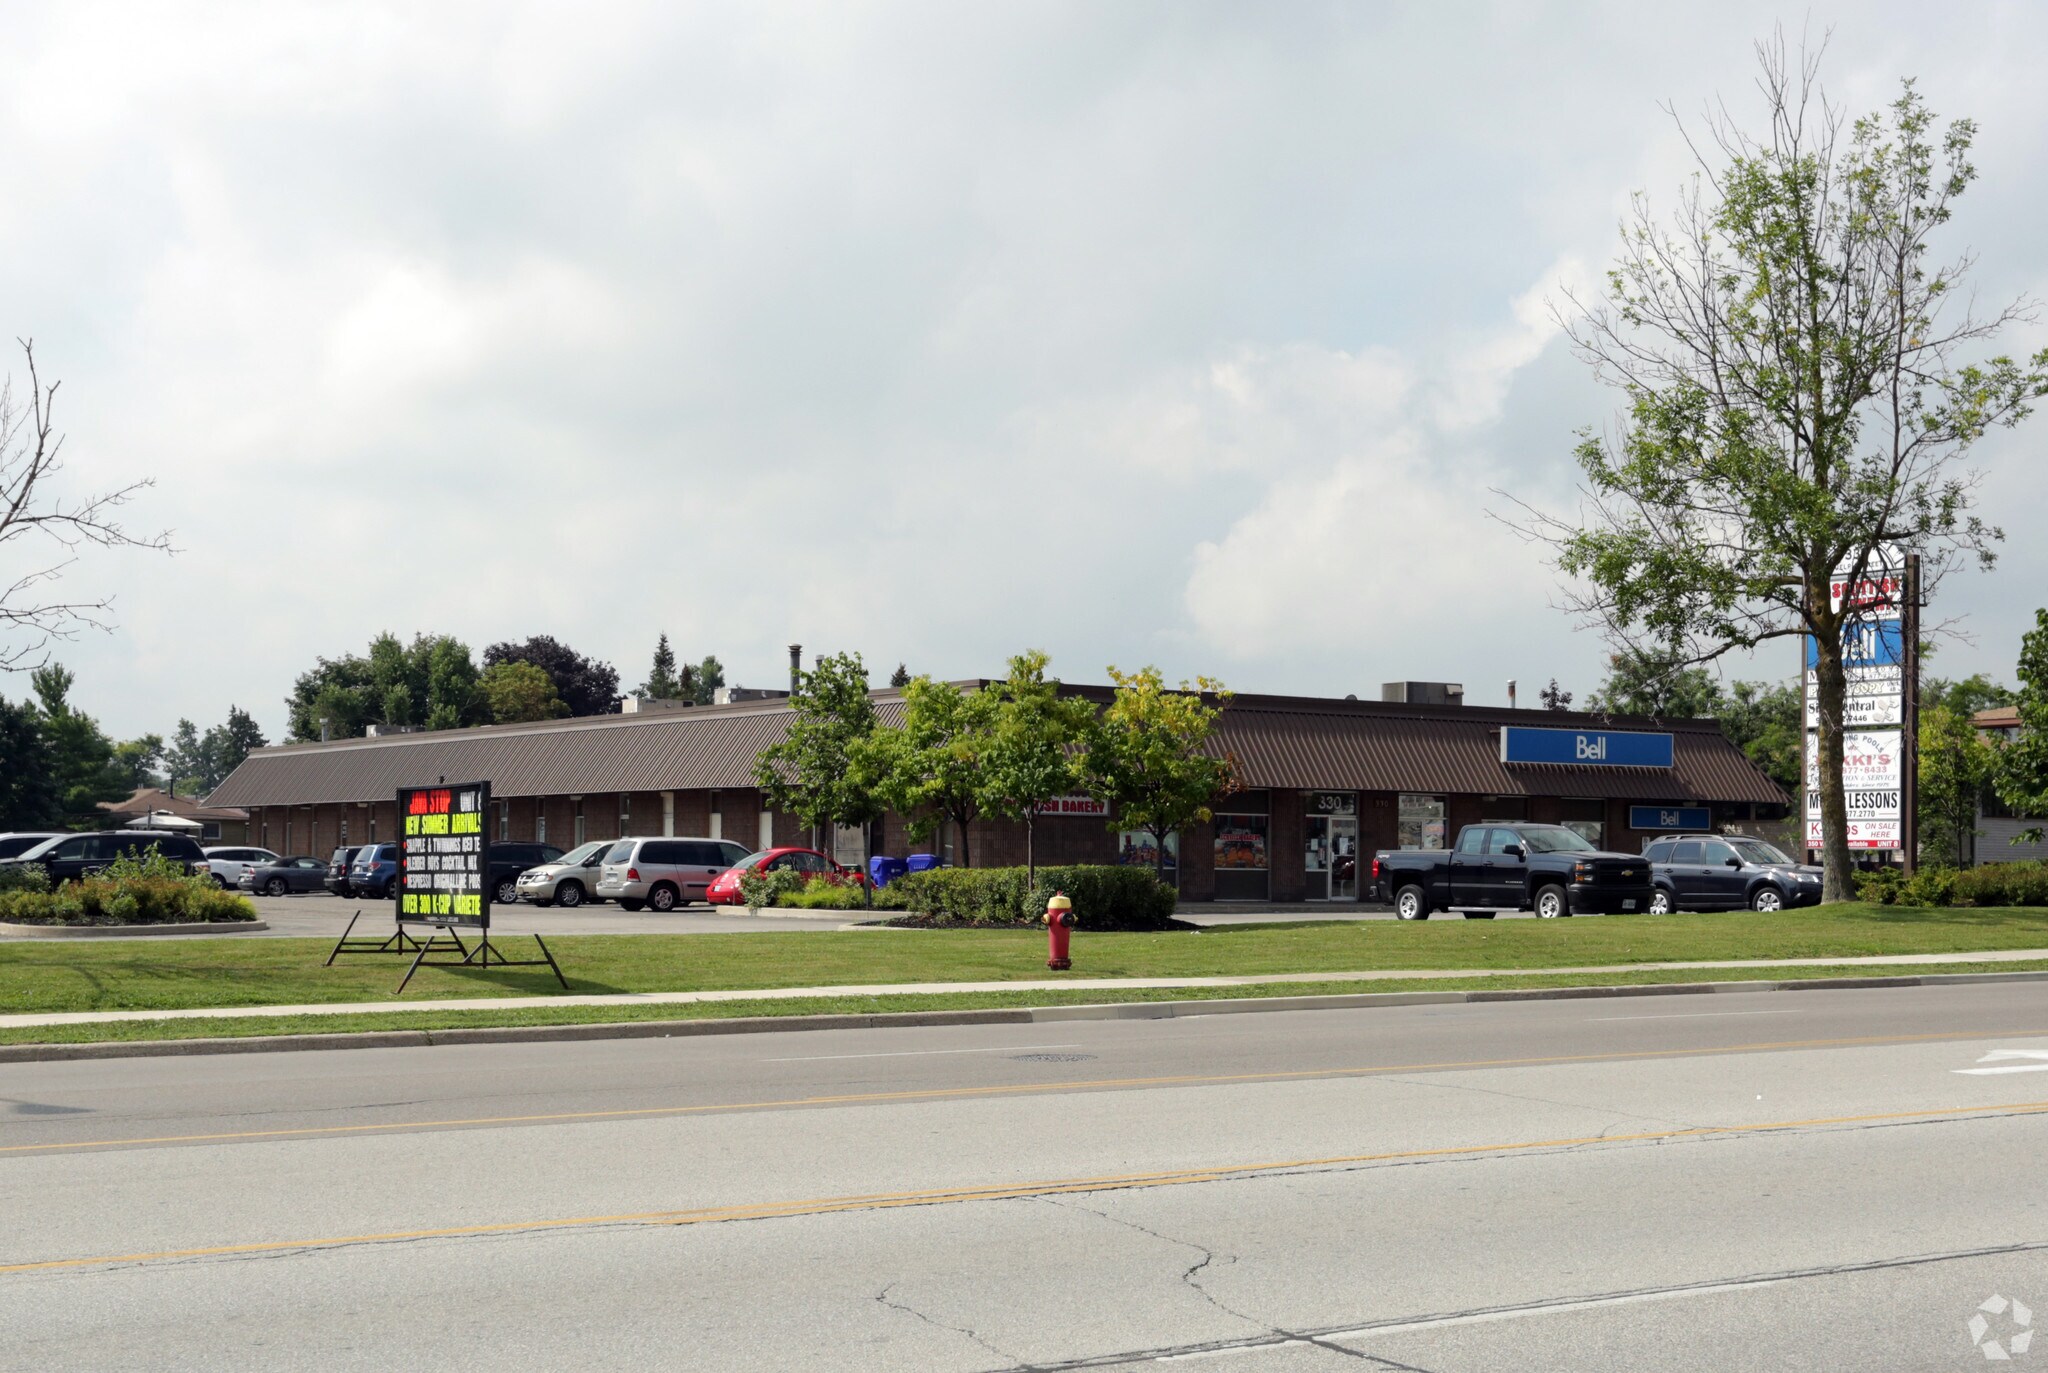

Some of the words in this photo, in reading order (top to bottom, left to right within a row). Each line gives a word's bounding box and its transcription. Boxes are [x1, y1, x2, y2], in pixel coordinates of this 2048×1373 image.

[1576, 735, 1606, 760] Bell
[1863, 735, 1884, 753] POOLS
[430, 789, 451, 814] STOP
[461, 791, 476, 812] UNIT
[1062, 800, 1105, 814] BAKERY
[1318, 796, 1342, 810] 330
[1849, 792, 1898, 809] LESSONS
[406, 815, 420, 835] NEW
[422, 814, 449, 835] SUMMER
[452, 812, 482, 834] ARRIVALS
[1660, 810, 1680, 826] Bell
[1865, 822, 1877, 830] ON
[1879, 822, 1897, 830] SALE
[402, 894, 418, 914] OVER
[420, 894, 431, 914] 300
[432, 894, 451, 915] K-CUP
